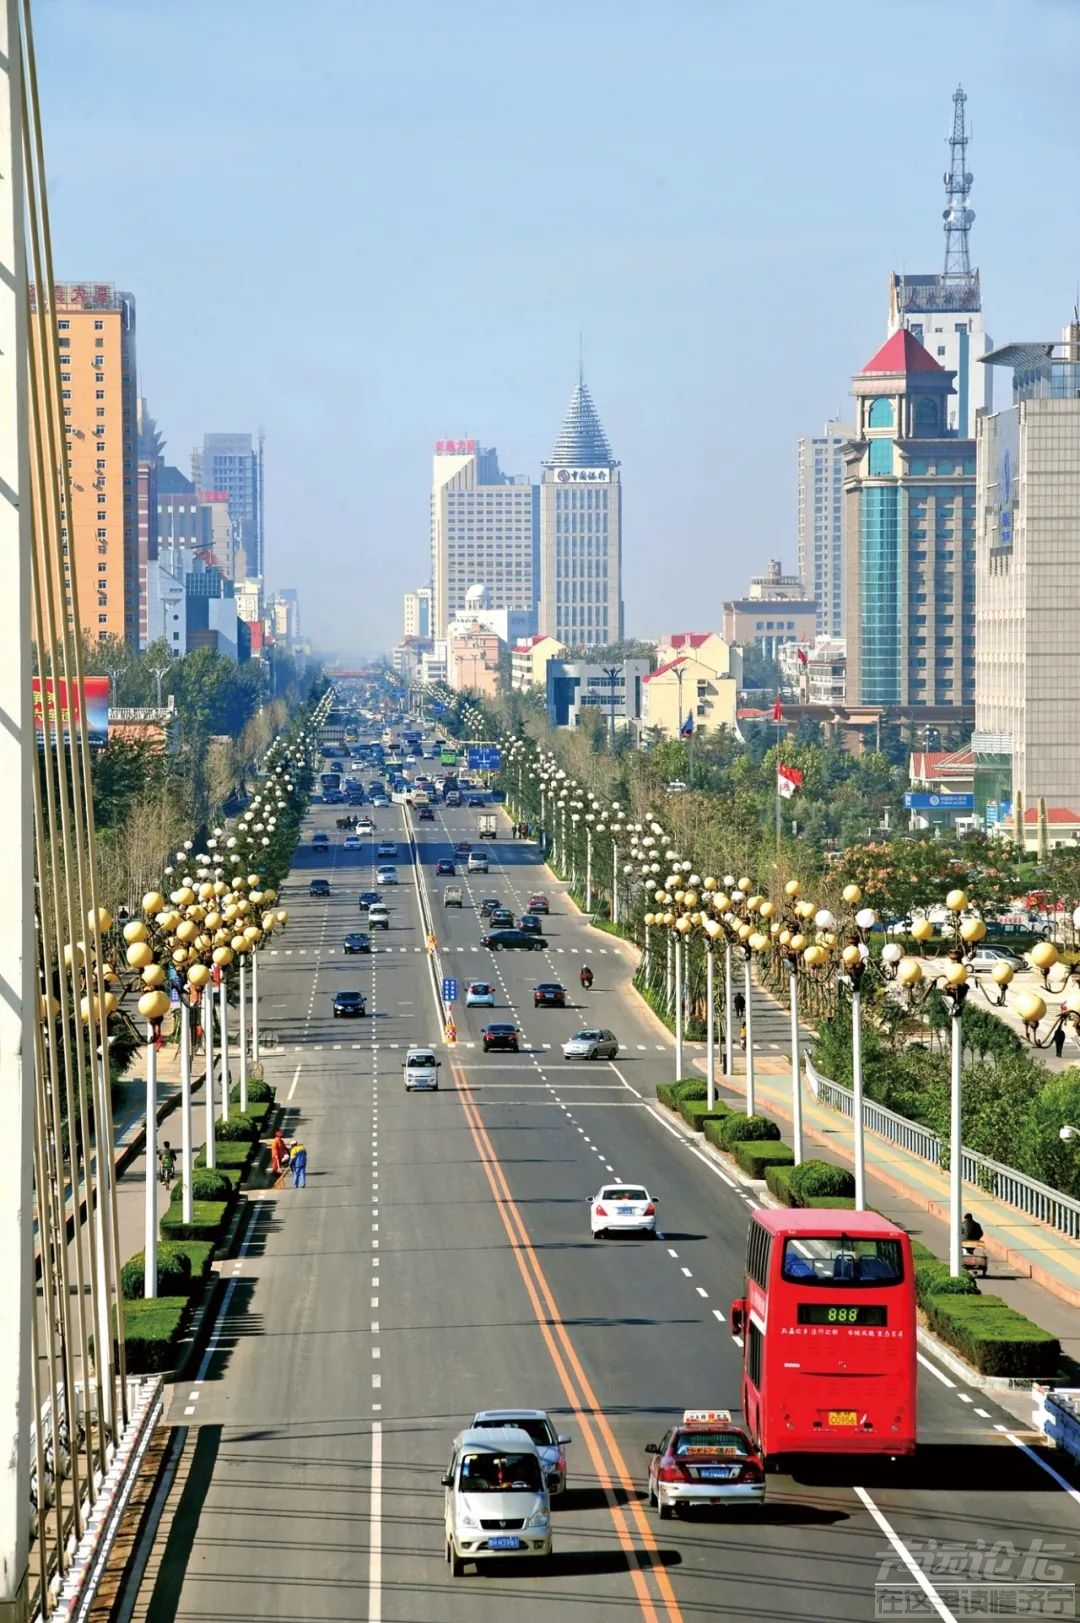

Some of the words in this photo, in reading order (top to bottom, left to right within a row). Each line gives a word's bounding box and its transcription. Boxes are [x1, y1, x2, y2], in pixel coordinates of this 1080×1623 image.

[571, 470, 607, 481] 中国银行
[828, 1308, 858, 1322] 888
